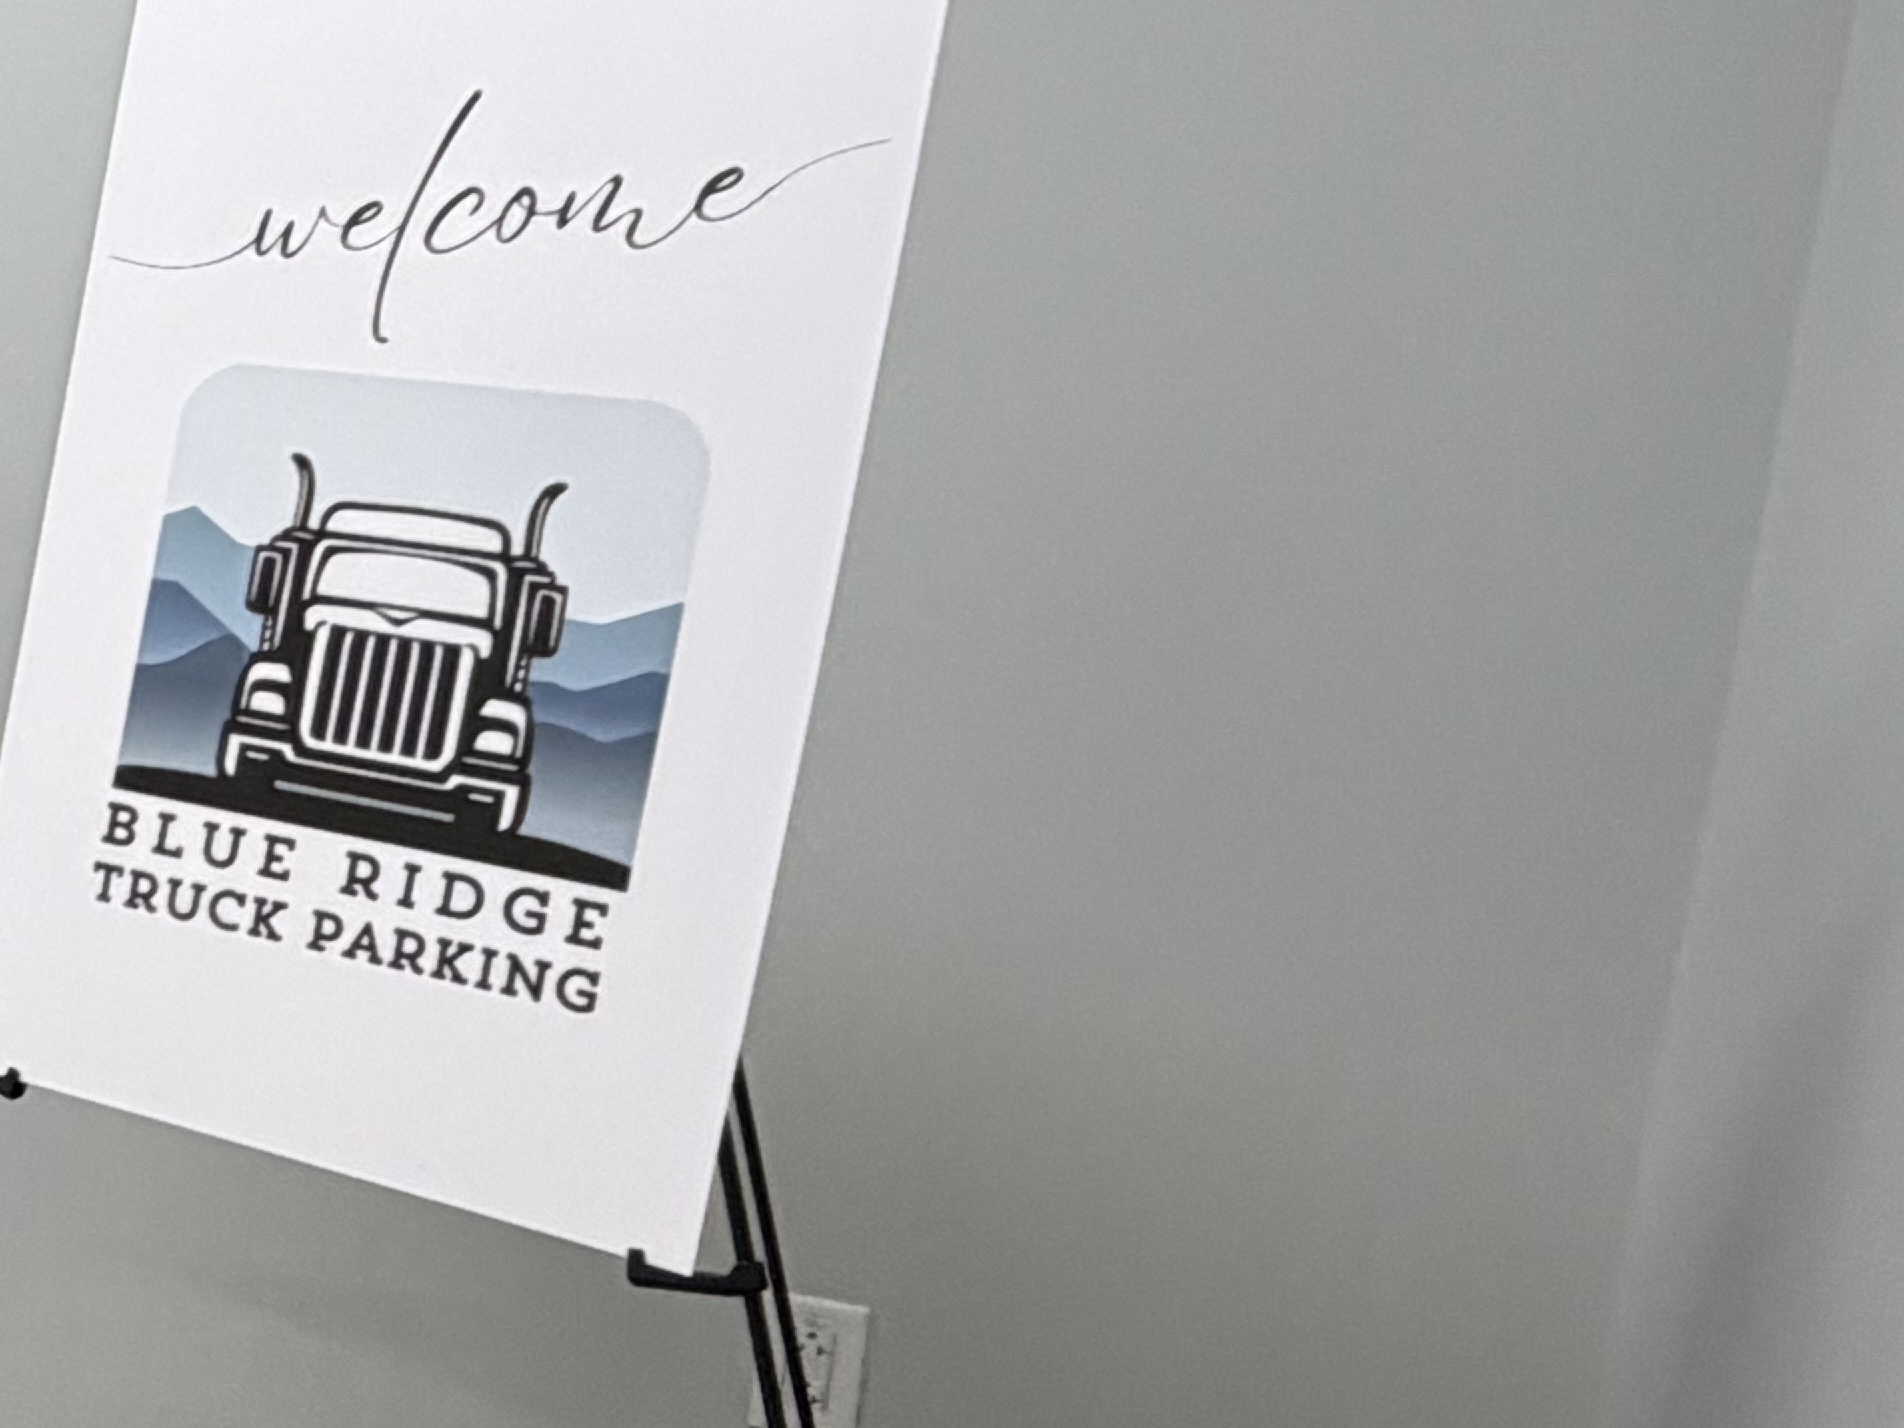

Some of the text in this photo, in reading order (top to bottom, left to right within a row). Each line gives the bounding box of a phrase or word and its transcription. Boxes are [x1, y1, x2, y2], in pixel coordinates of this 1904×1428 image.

[108, 88, 892, 344] welcome
[91, 862, 602, 1014] TRUCK PARKING
[100, 801, 610, 951] BLUE RIDGE
